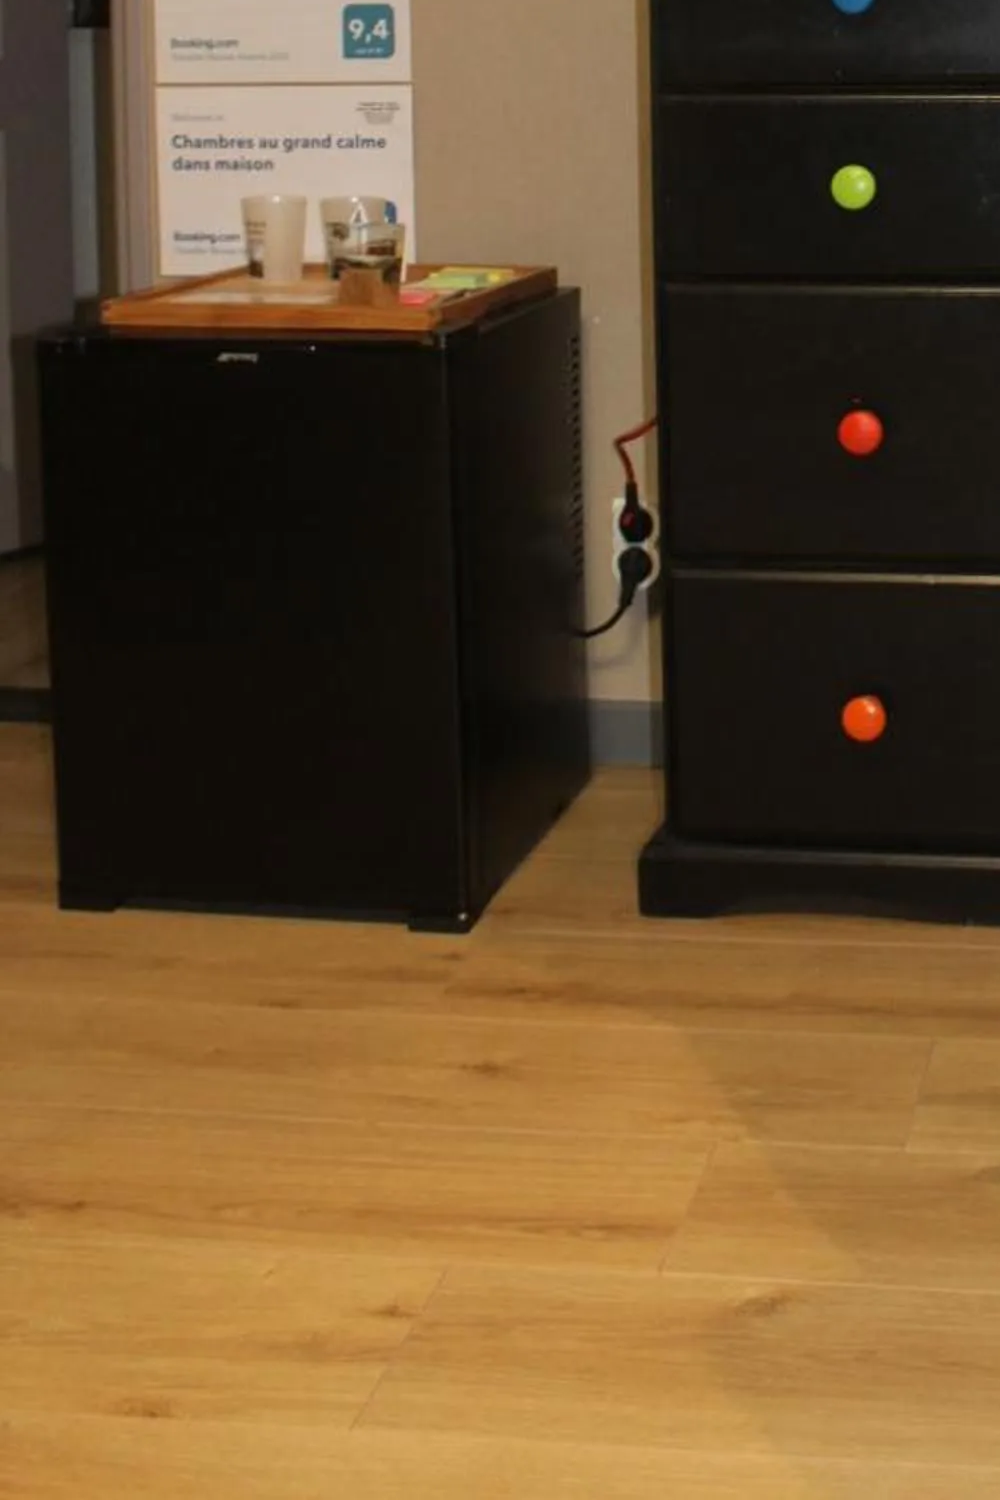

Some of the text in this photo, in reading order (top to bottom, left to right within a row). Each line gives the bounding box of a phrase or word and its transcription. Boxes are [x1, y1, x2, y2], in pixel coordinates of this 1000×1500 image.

[348, 18, 390, 43] 9,4
[171, 134, 387, 153] Chambres au grand calme
[172, 156, 274, 171] dans maison
